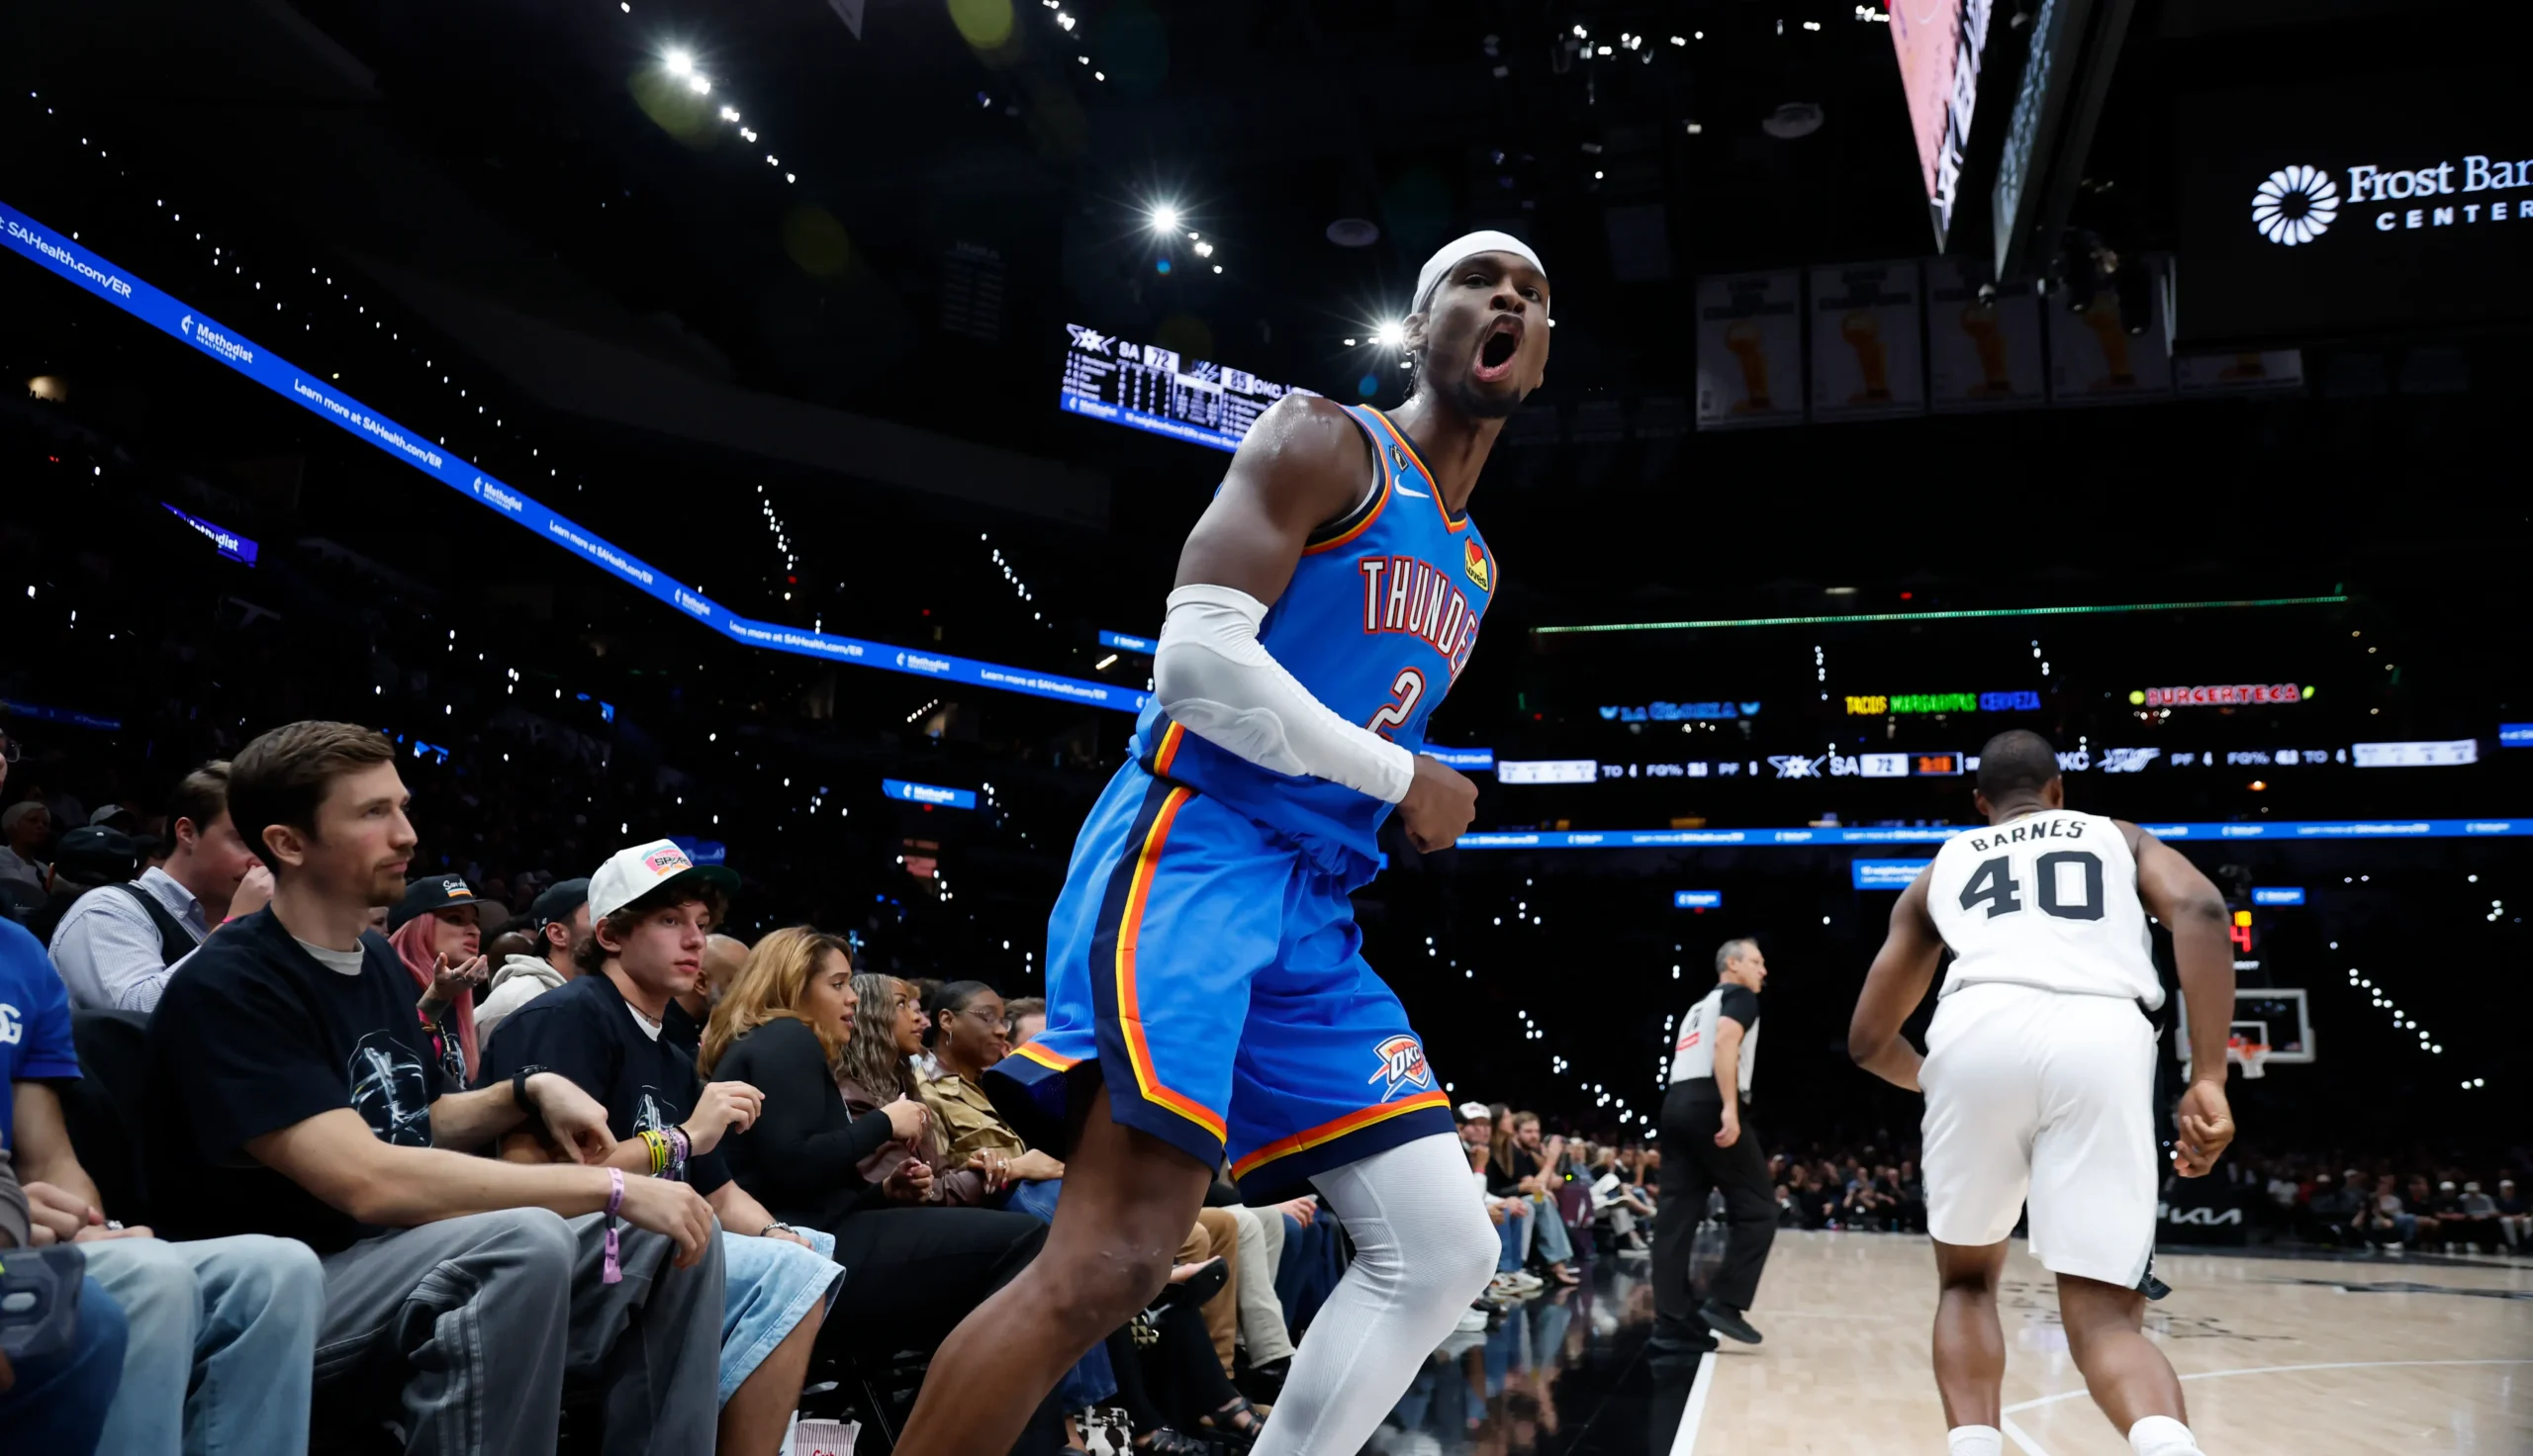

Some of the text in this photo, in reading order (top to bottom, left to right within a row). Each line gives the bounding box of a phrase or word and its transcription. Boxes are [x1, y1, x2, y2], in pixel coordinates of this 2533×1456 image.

[2347, 160, 2455, 203] Frost
[7, 221, 133, 299] SAHealth.com/ER
[197, 322, 254, 365] Methodist
[1254, 379, 1282, 400] OKC
[294, 378, 442, 469] Learn more at SAHealth.com/ER
[549, 519, 570, 540] Learn
[1359, 555, 1478, 691] THUNDE
[1364, 666, 1426, 742] 2
[1845, 695, 1887, 715] TACOS
[2145, 683, 2301, 707] BURGERTECA
[1829, 756, 1860, 776] SA
[1971, 819, 2087, 853] BARNES
[1959, 851, 2105, 921] 40
[1389, 1046, 1421, 1082] OKC
